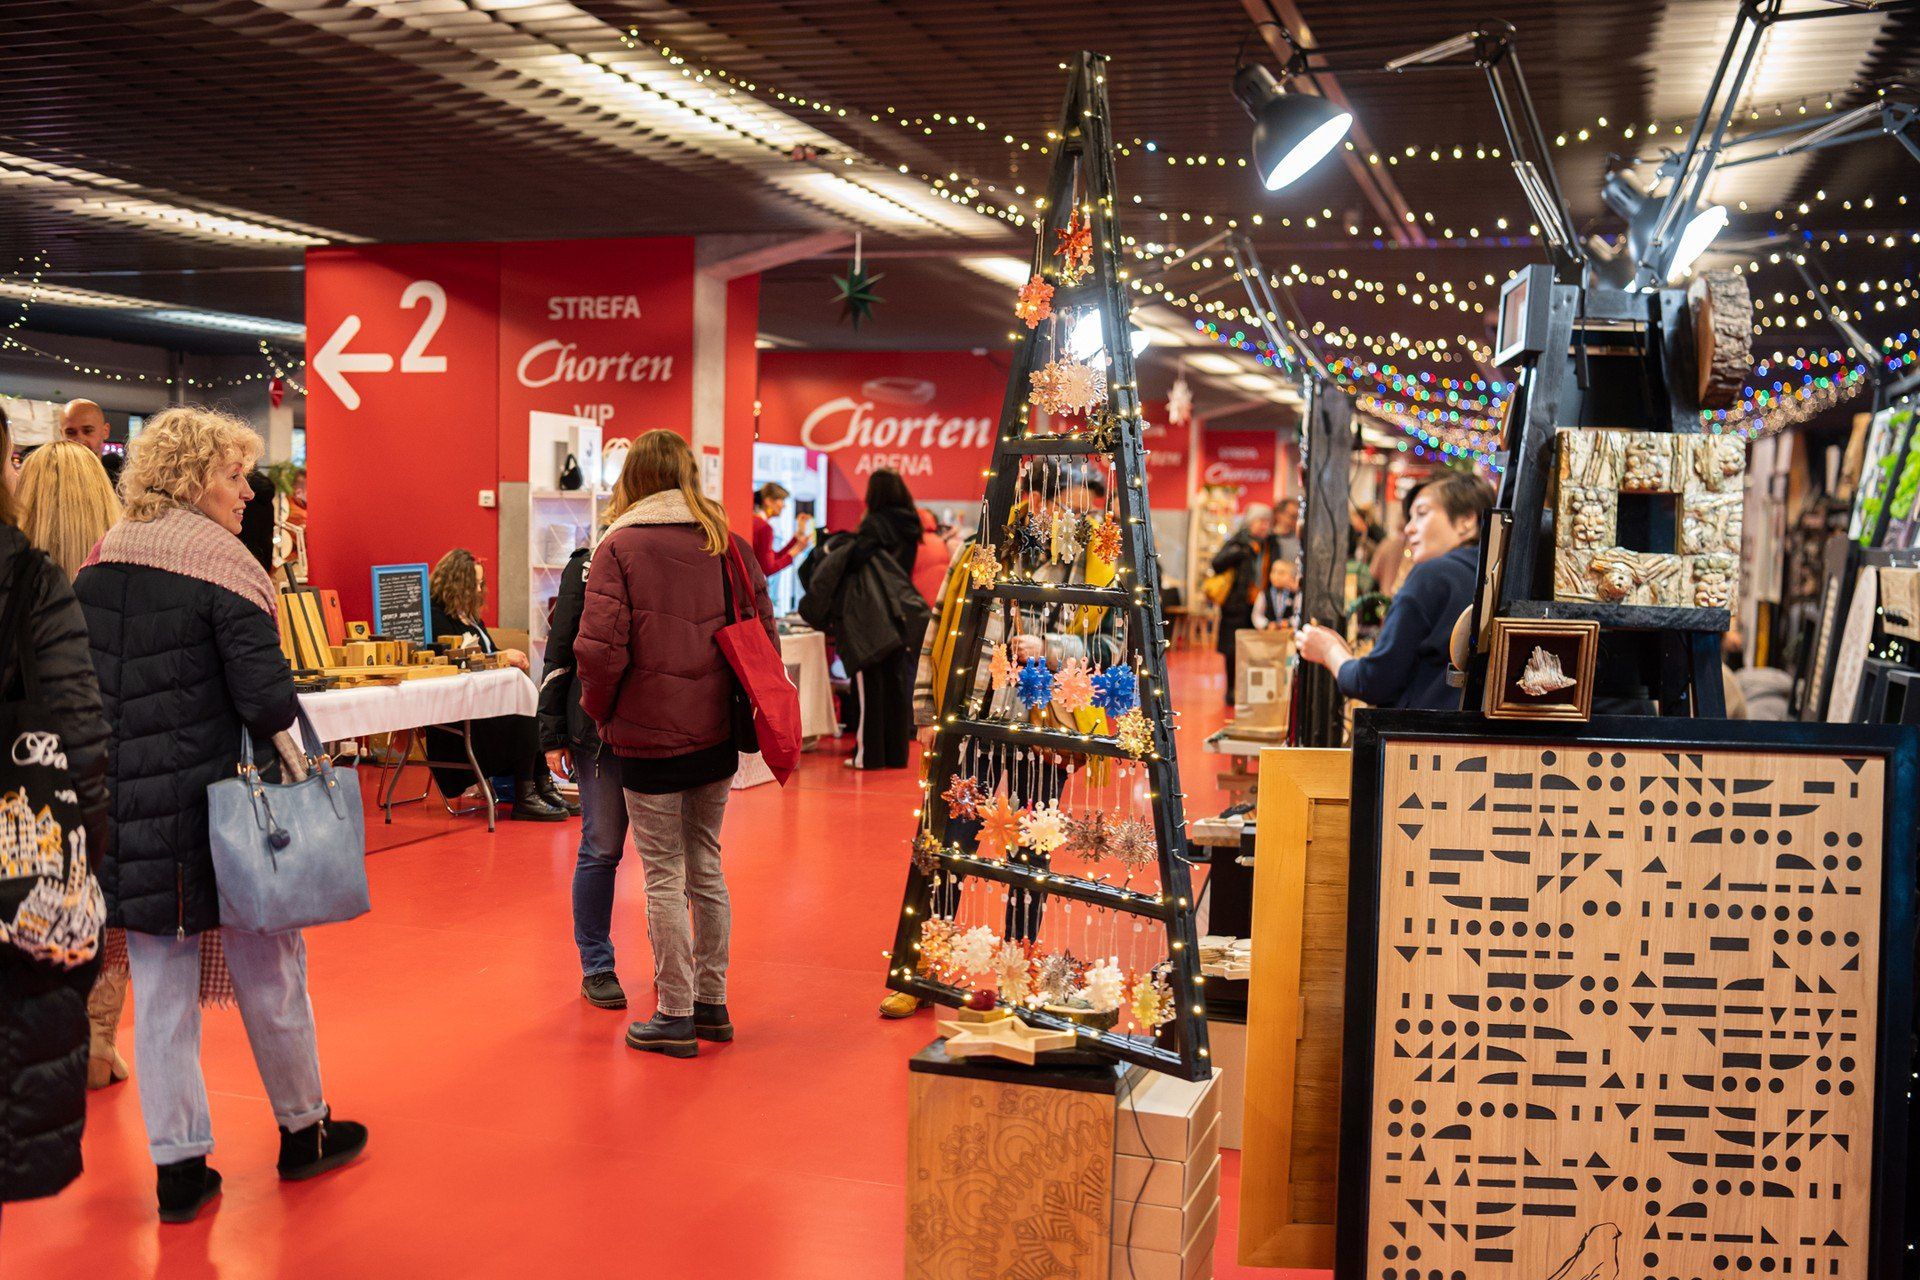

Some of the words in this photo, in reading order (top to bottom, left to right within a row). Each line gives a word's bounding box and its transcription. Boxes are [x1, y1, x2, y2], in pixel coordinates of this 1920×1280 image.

[399, 280, 448, 373] 2
[548, 295, 641, 321] STREFA
[516, 338, 674, 389] Chorten
[800, 396, 993, 453] Chorten
[854, 452, 933, 477] ARENA
